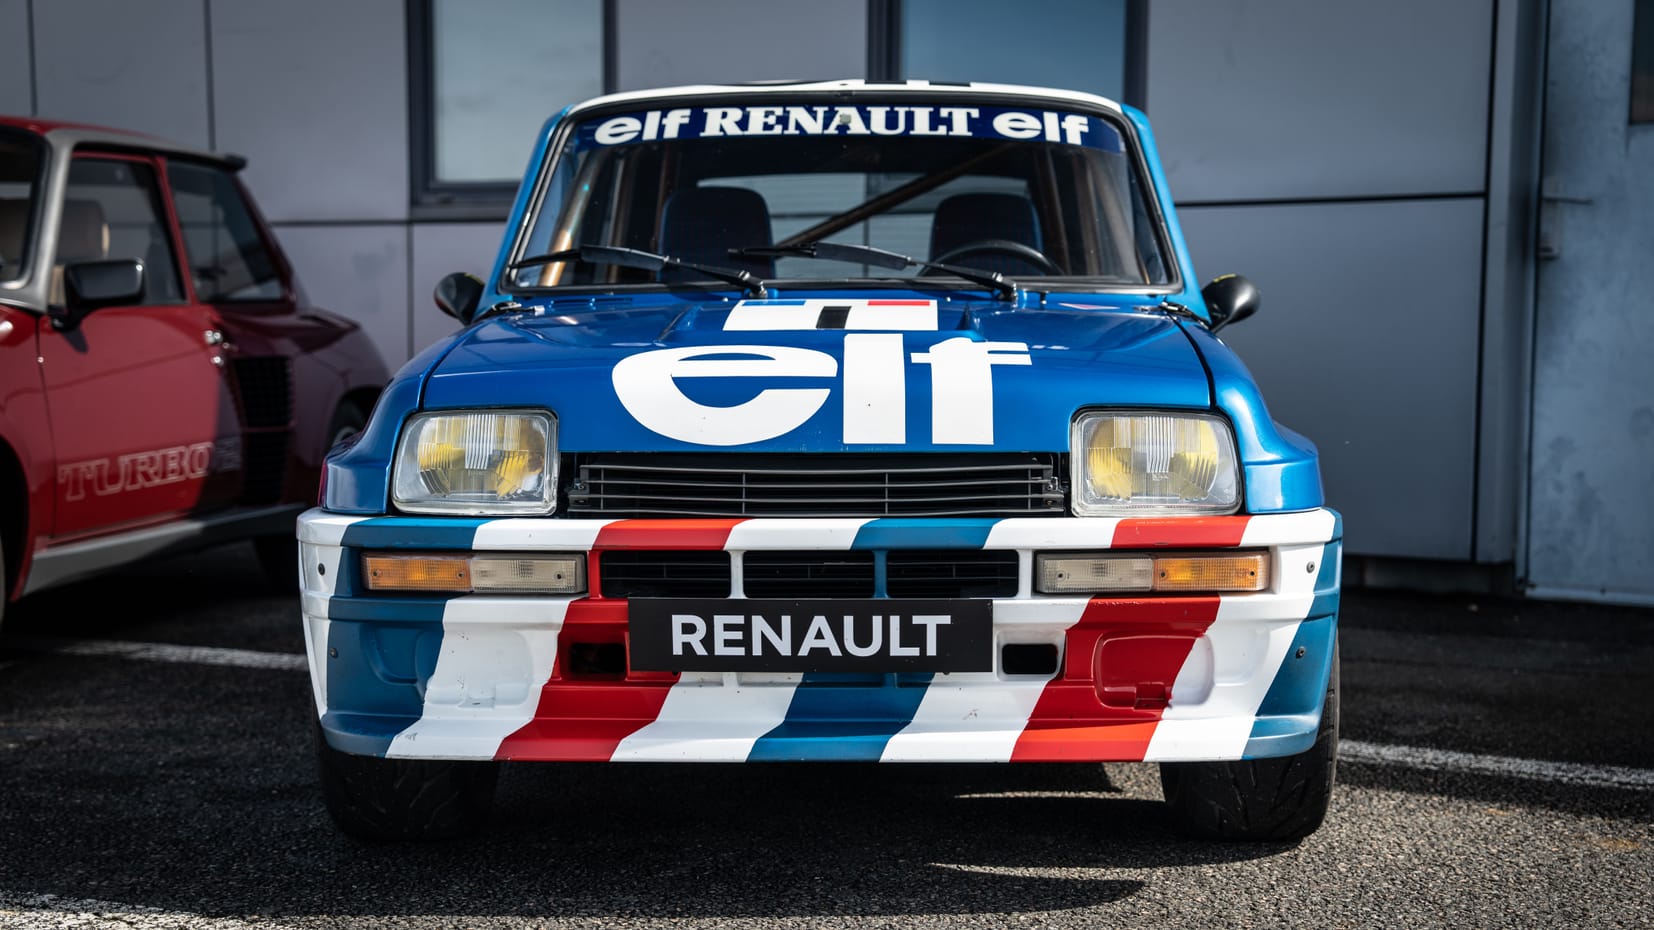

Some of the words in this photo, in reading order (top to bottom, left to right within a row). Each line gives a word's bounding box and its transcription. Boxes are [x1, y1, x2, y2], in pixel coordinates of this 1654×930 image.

[594, 109, 691, 145] elf
[699, 106, 980, 136] RENAULT
[992, 111, 1089, 146] elf
[611, 333, 1033, 446] elf
[58, 441, 215, 501] TURBO
[671, 614, 952, 657] RENAULT
